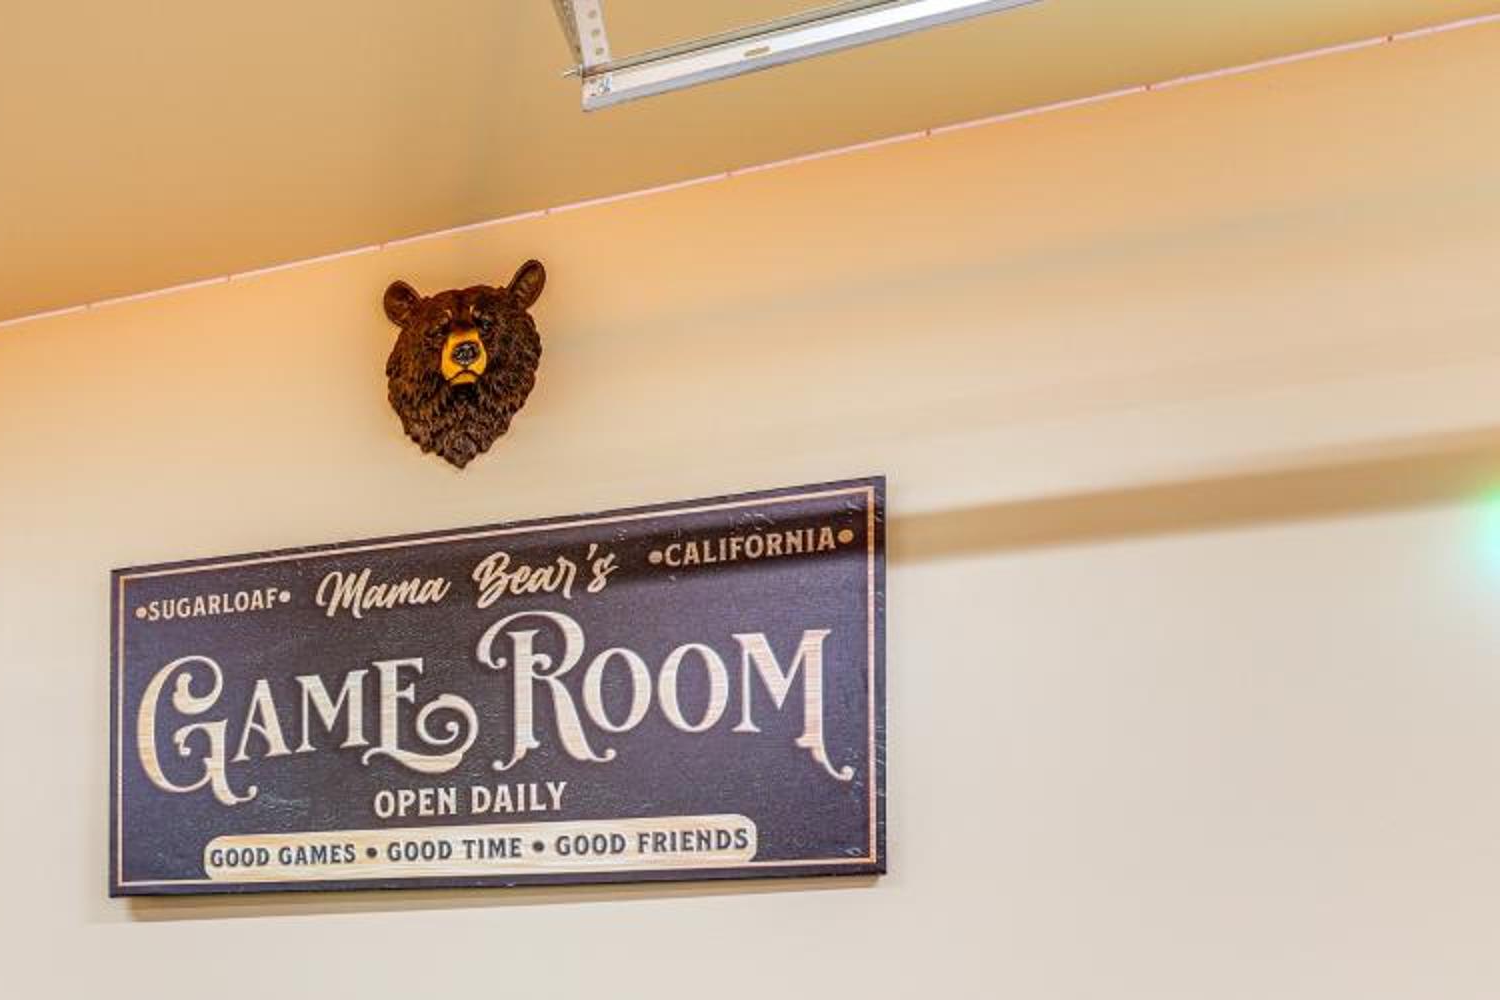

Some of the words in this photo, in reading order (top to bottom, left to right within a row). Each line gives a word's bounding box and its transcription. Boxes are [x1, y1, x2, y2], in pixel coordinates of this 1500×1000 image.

[663, 526, 836, 568] CALIFORNIA
[315, 567, 451, 619] Mama
[471, 543, 619, 609] Bear's
[147, 588, 279, 622] SUGARLOAF
[136, 655, 479, 805] GAME
[478, 611, 854, 781] ROOM
[374, 787, 457, 818] OPEN
[471, 781, 567, 814] DAILY
[210, 846, 270, 867] GOOD
[278, 843, 356, 866] GAMES
[387, 840, 452, 861] GOOD
[462, 837, 522, 859] TIME
[555, 832, 626, 856] GOOD
[637, 827, 749, 853] FRIENDS
